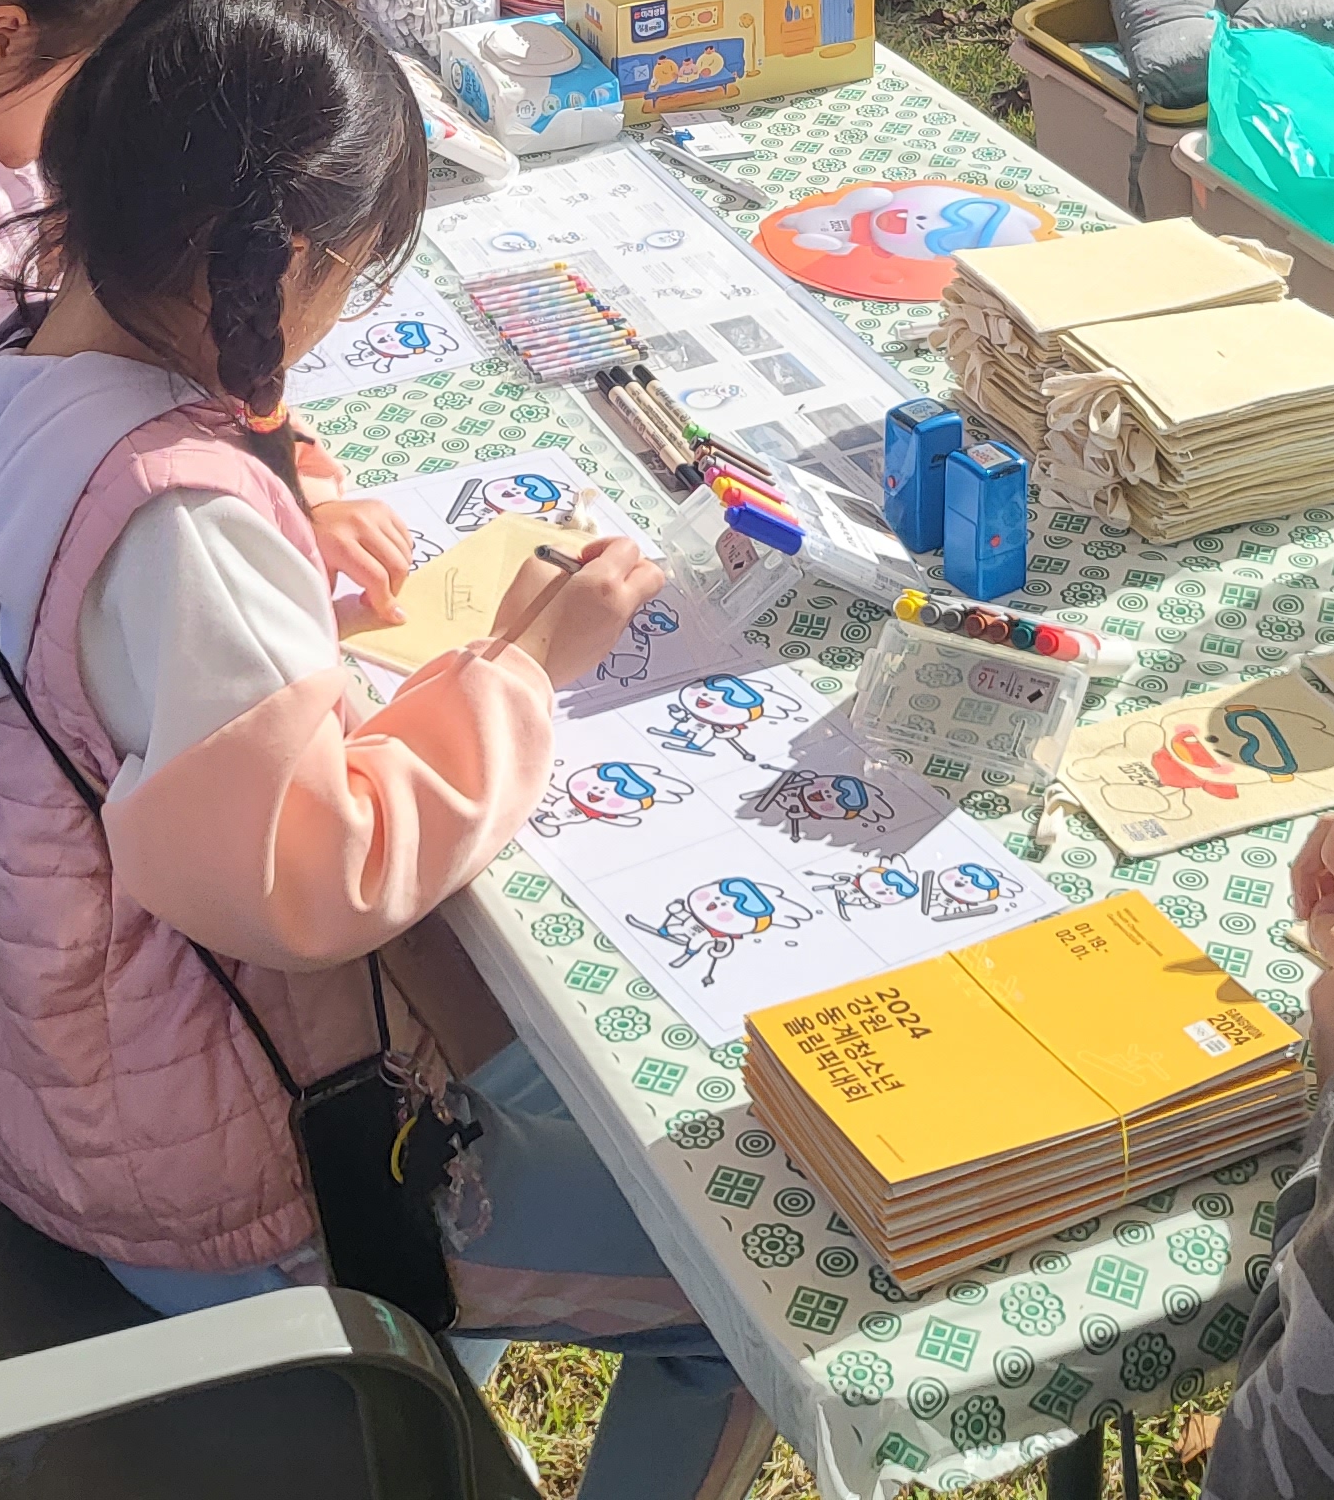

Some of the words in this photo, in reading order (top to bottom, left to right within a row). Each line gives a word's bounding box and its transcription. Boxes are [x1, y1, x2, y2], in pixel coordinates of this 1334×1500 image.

[846, 994, 895, 1036] 강원
[875, 987, 933, 1040] 2024
[1207, 1013, 1252, 1046] 2024
[782, 1015, 875, 1103] 올림픽대회
[815, 1005, 907, 1094] 동계청소년
